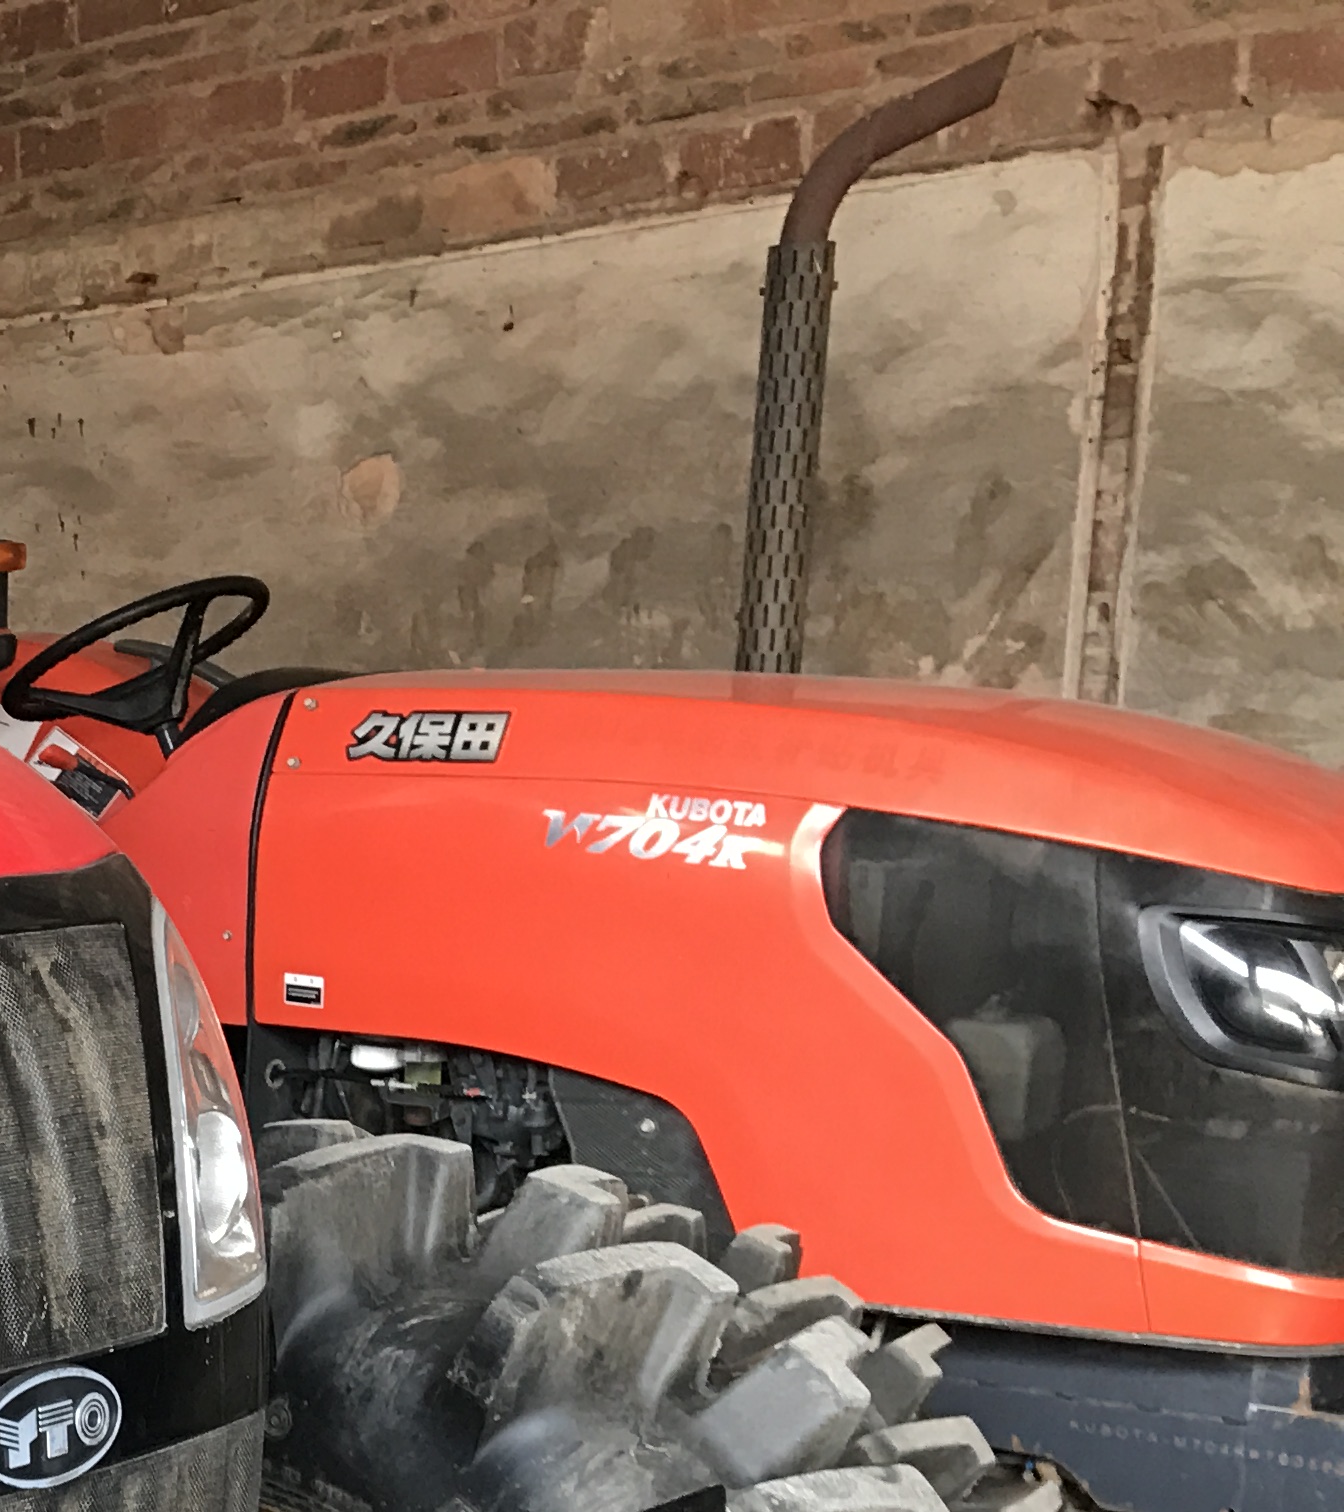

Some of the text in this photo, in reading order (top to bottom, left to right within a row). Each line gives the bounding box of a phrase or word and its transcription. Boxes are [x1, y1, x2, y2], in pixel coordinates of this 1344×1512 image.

[347, 711, 511, 763] 久保田
[645, 793, 766, 827] KUBOTA
